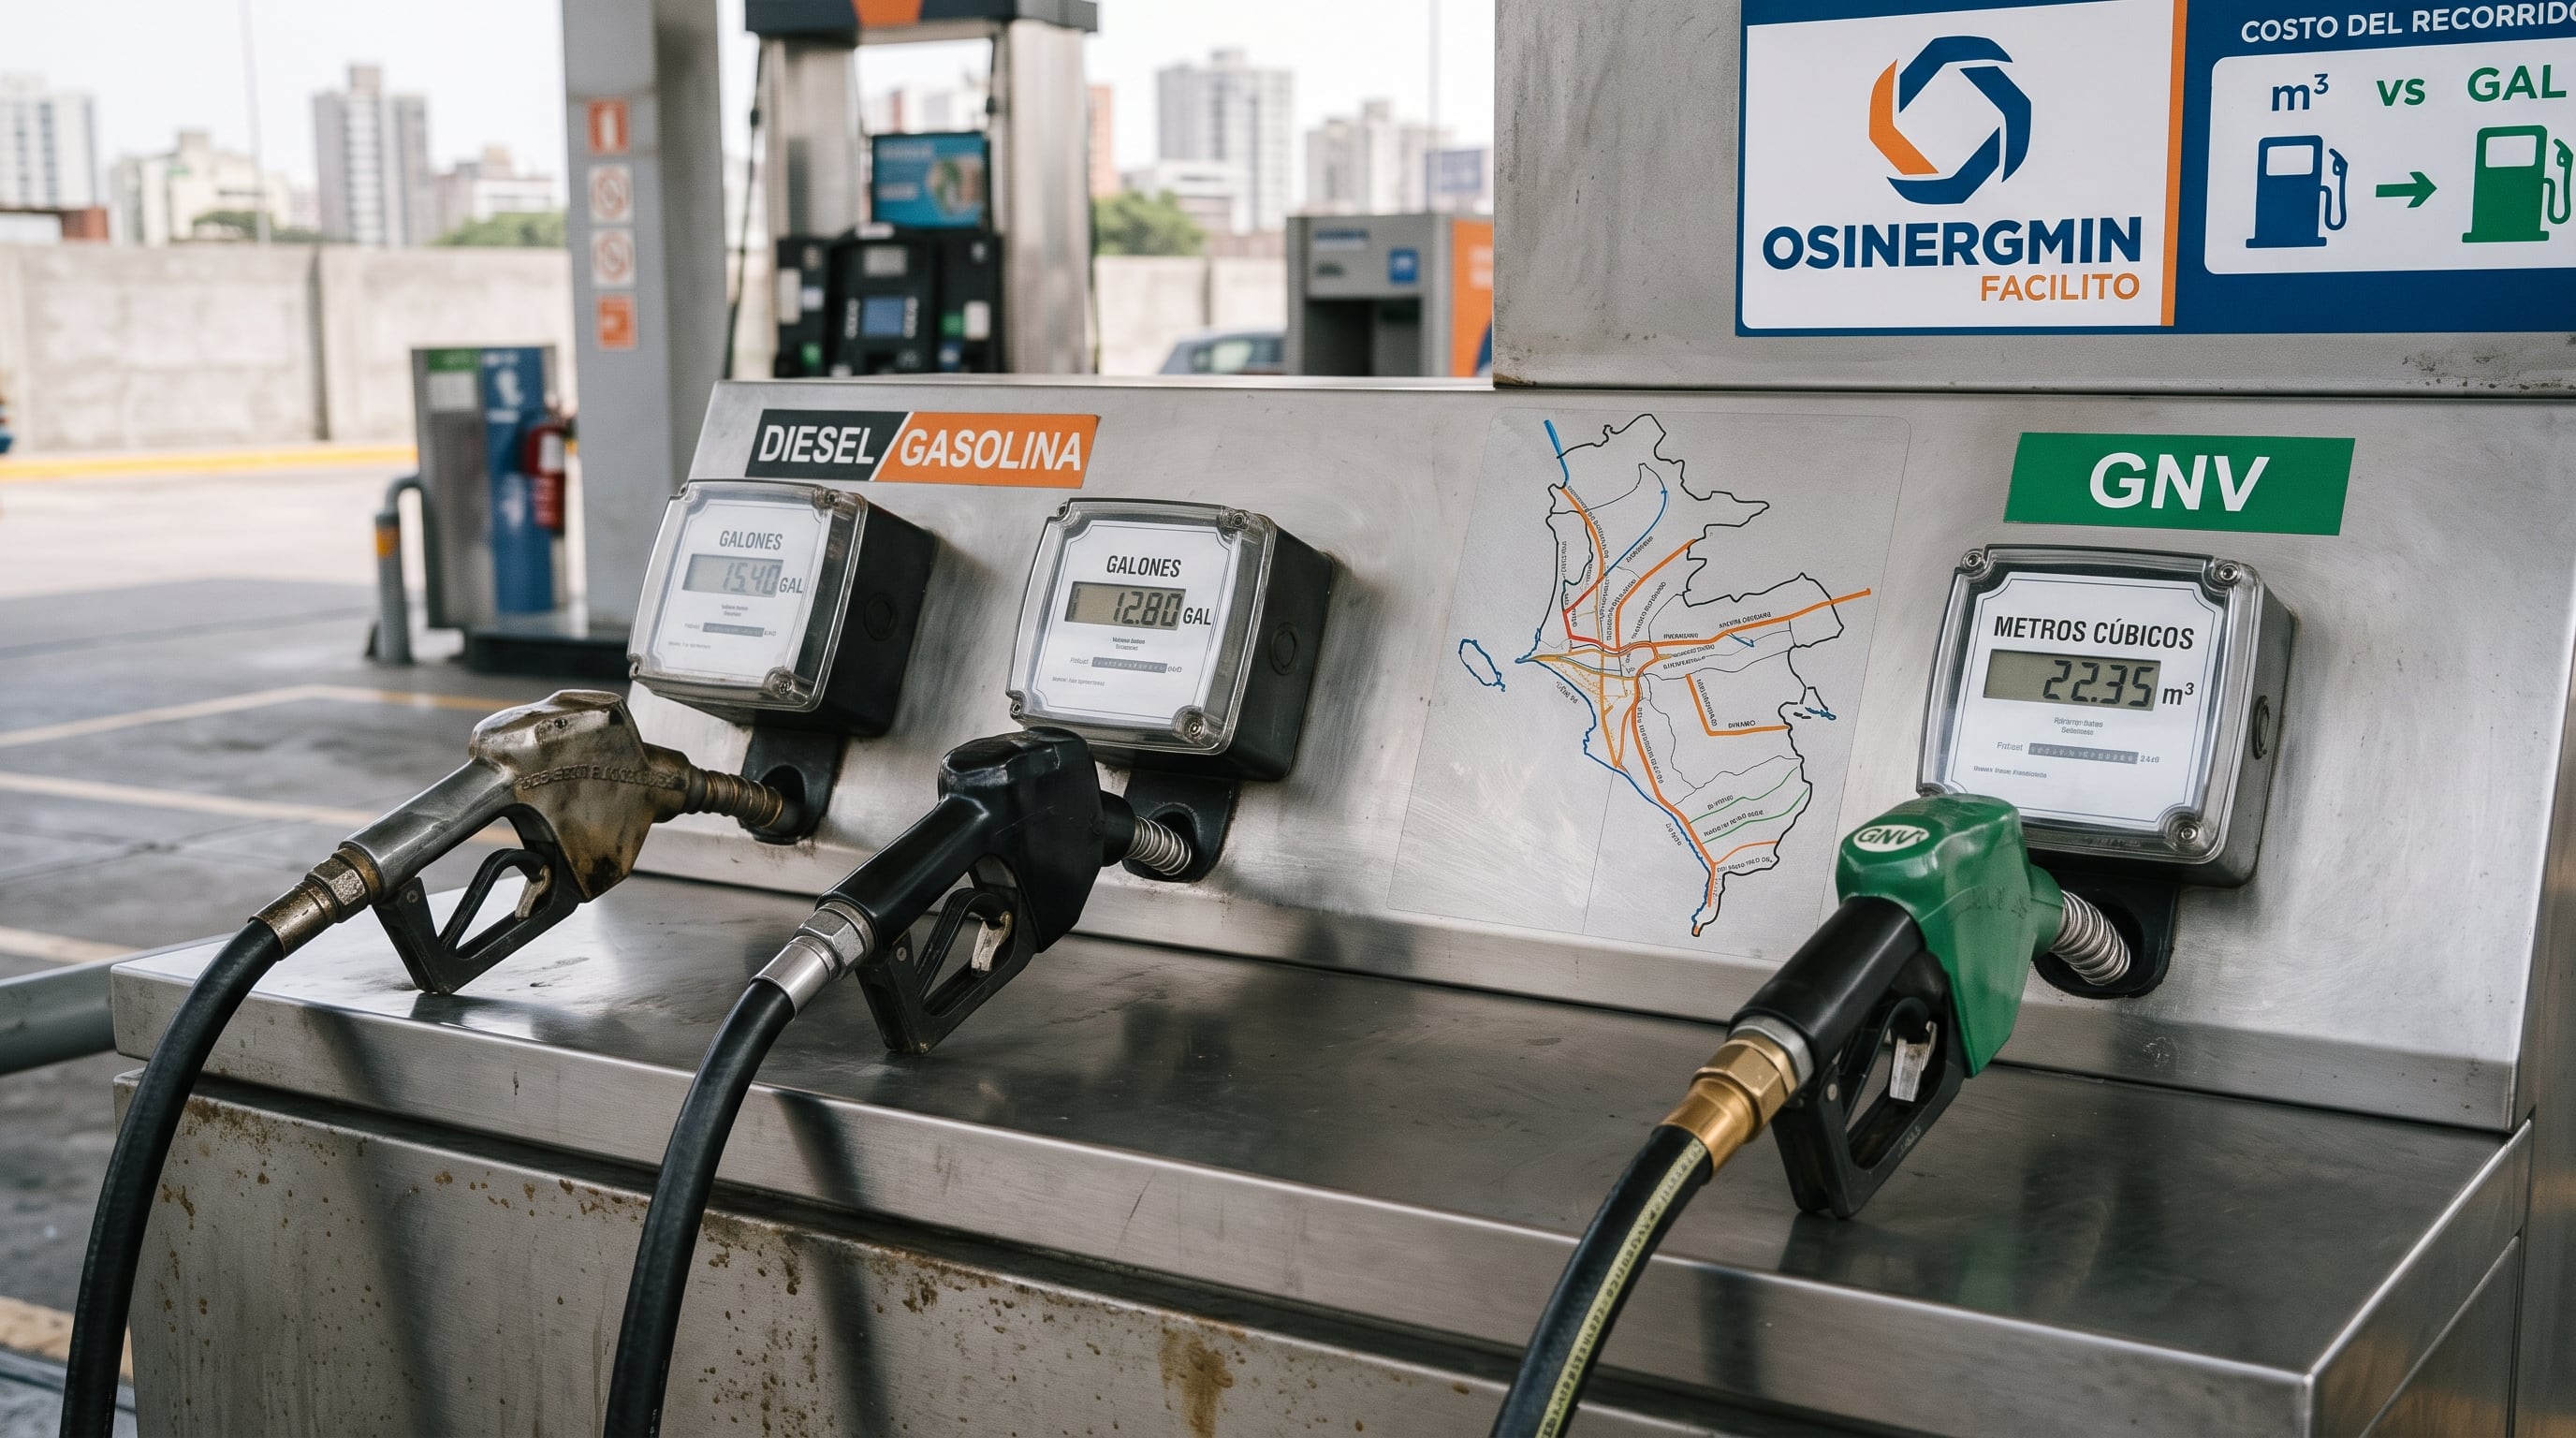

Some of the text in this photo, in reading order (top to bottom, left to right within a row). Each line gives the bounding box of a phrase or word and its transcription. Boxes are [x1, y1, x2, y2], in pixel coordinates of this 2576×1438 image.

[2241, 16, 2338, 43] COSTO
[2347, 12, 2402, 37] DEL
[2466, 64, 2568, 103] GAL
[1763, 216, 2142, 270] OSINERGMIN
[1981, 272, 2141, 301] FACILITO
[757, 424, 876, 465] DIESEL
[900, 428, 1082, 471] GASOLINA
[2089, 452, 2270, 512] GNV
[719, 530, 783, 550] GALONES
[1106, 555, 1182, 578] GALONES
[779, 578, 804, 594] GAL
[1113, 591, 1183, 626] 12.80
[1183, 607, 1211, 625] GAL
[1994, 615, 2194, 651] METROS CÚBICOS
[2043, 659, 2155, 707] 22.35
